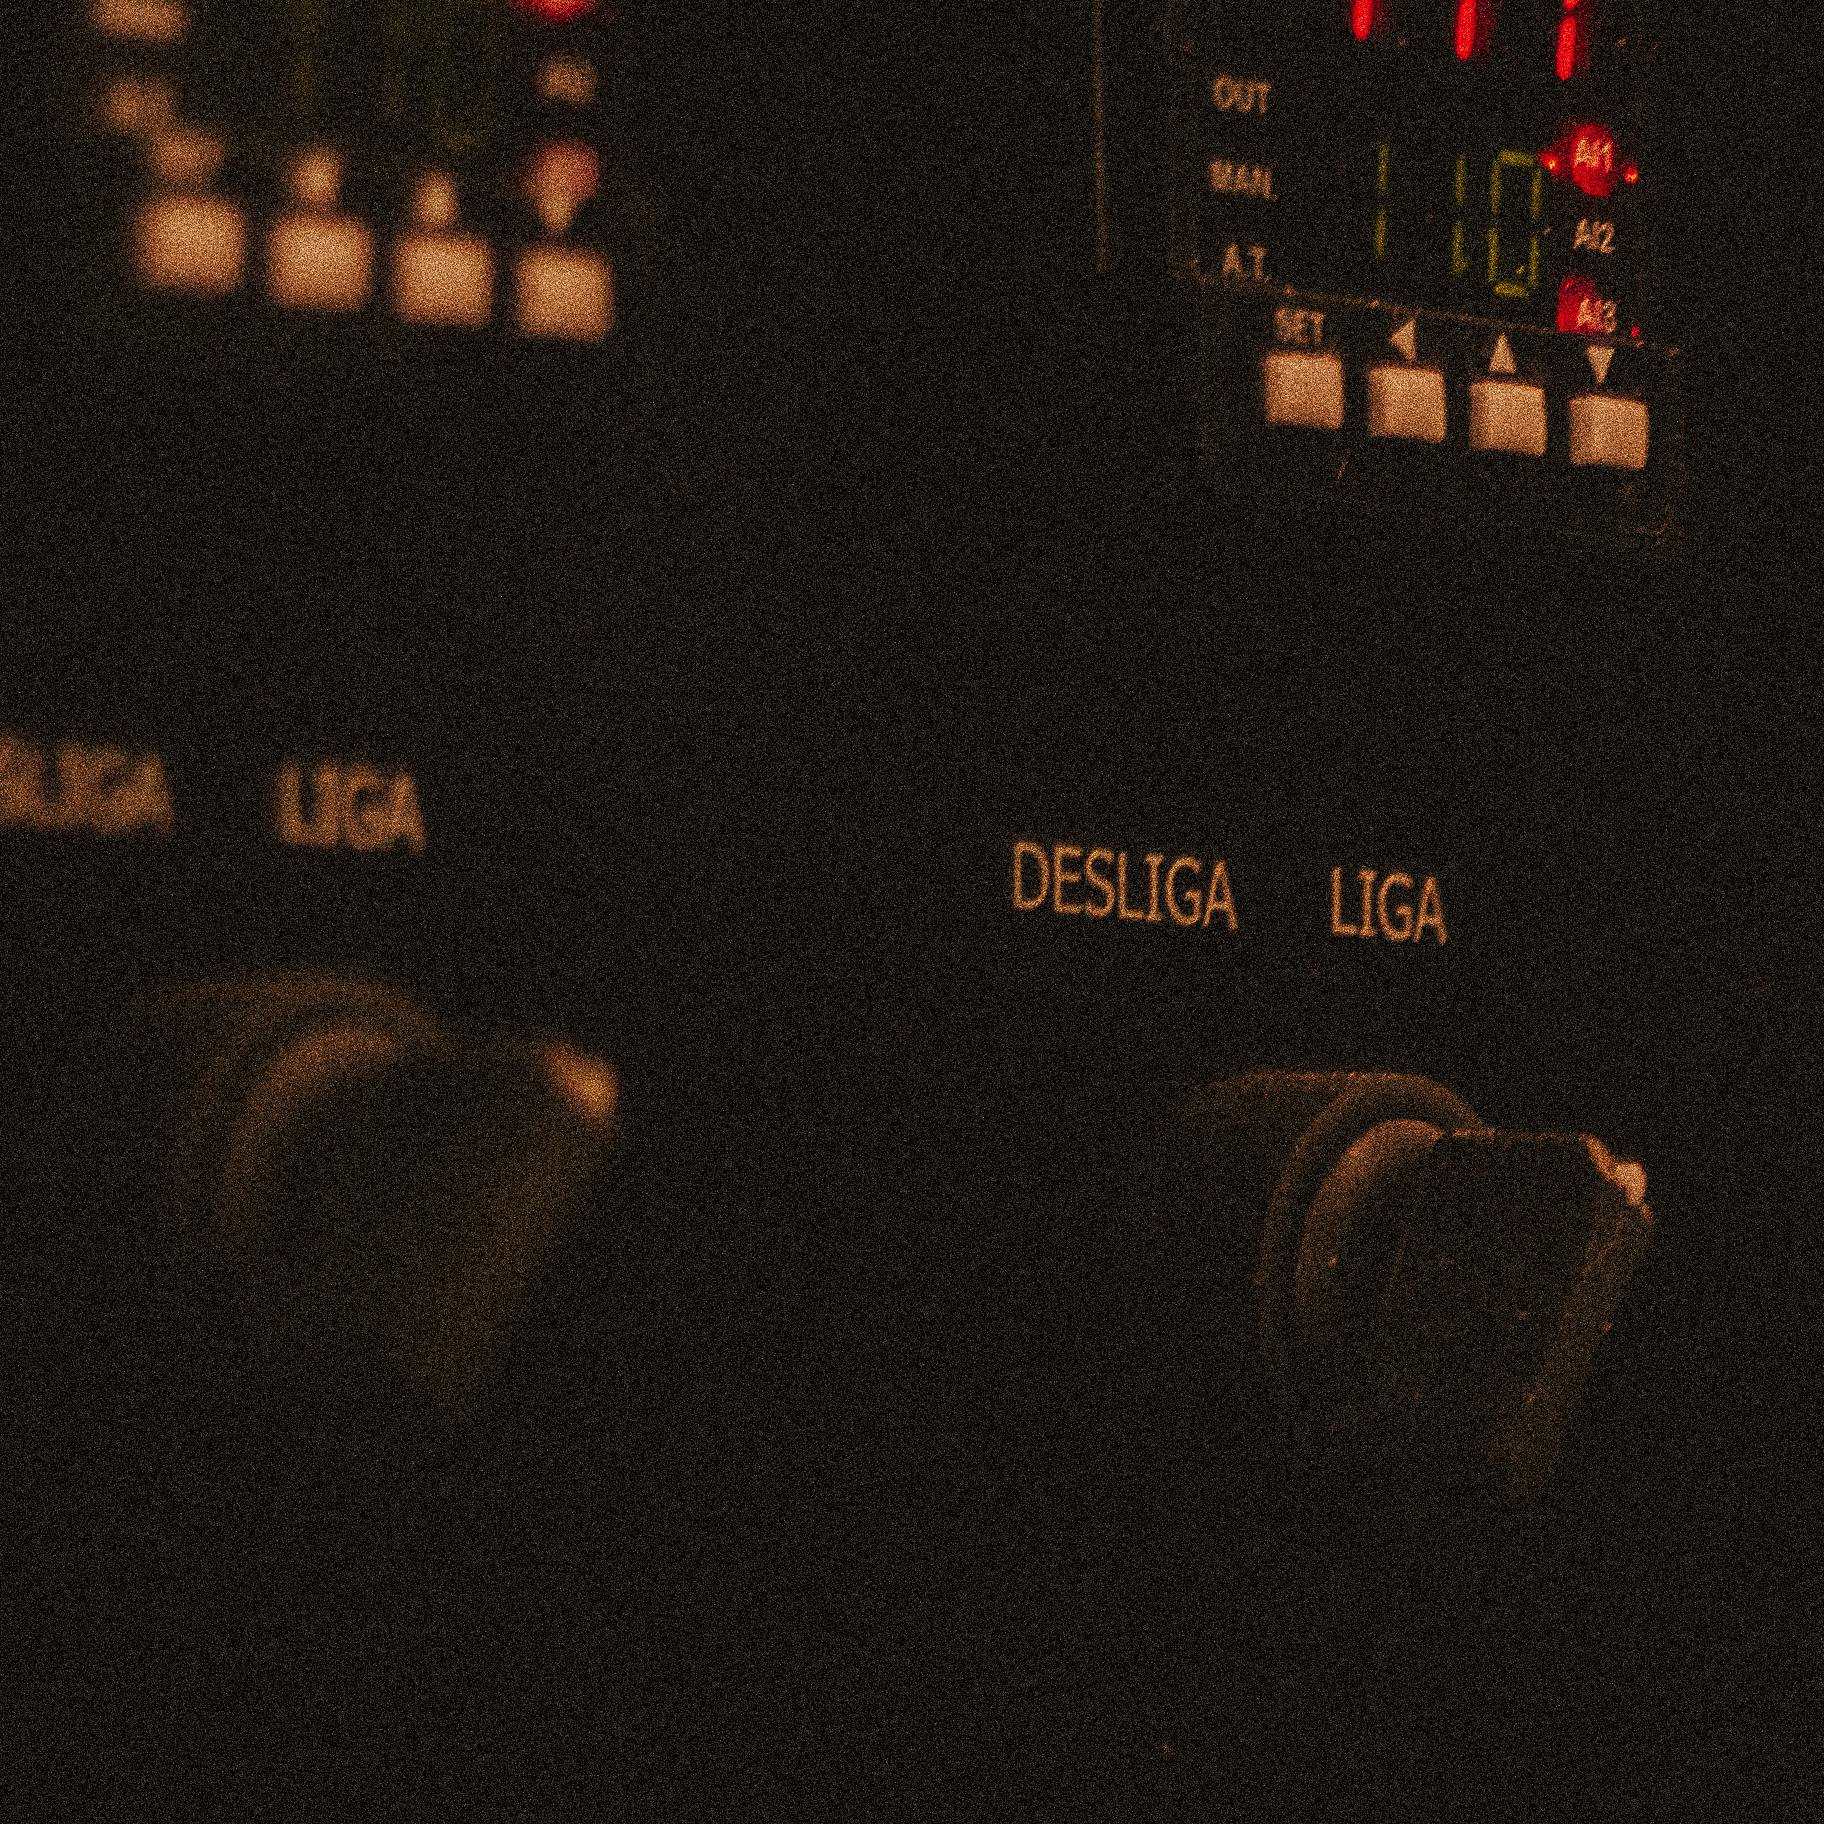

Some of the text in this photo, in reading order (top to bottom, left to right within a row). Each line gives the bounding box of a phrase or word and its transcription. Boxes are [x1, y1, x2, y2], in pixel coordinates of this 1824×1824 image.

[1210, 72, 1273, 114] OUT
[1374, 141, 1542, 298] 110
[1274, 306, 1327, 346] SET
[276, 760, 427, 856] LIGA
[1011, 838, 1449, 945] DESLIGA LIGA
